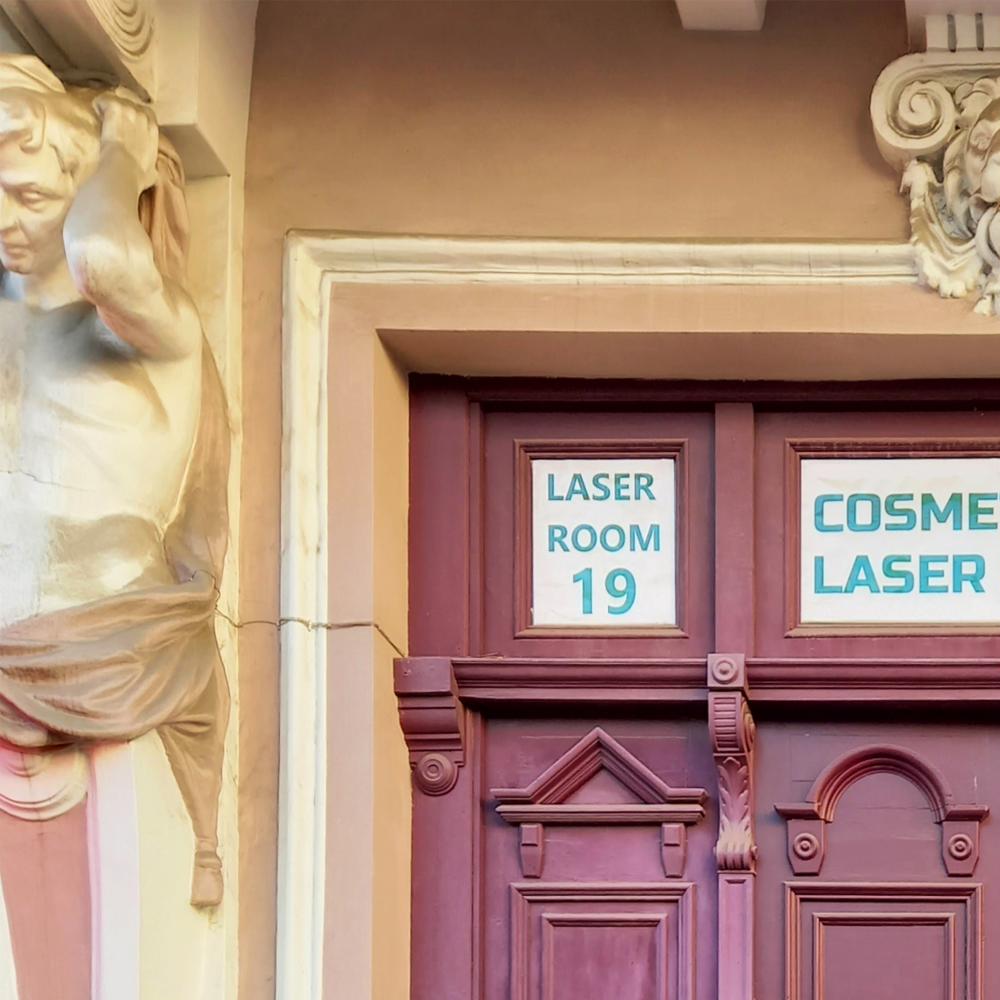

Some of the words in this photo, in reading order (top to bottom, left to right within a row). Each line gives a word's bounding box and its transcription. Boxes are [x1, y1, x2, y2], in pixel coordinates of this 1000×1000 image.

[547, 473, 656, 502] LASER
[548, 524, 661, 553] ROOM
[572, 567, 637, 616] 19
[814, 554, 986, 595] LASER
